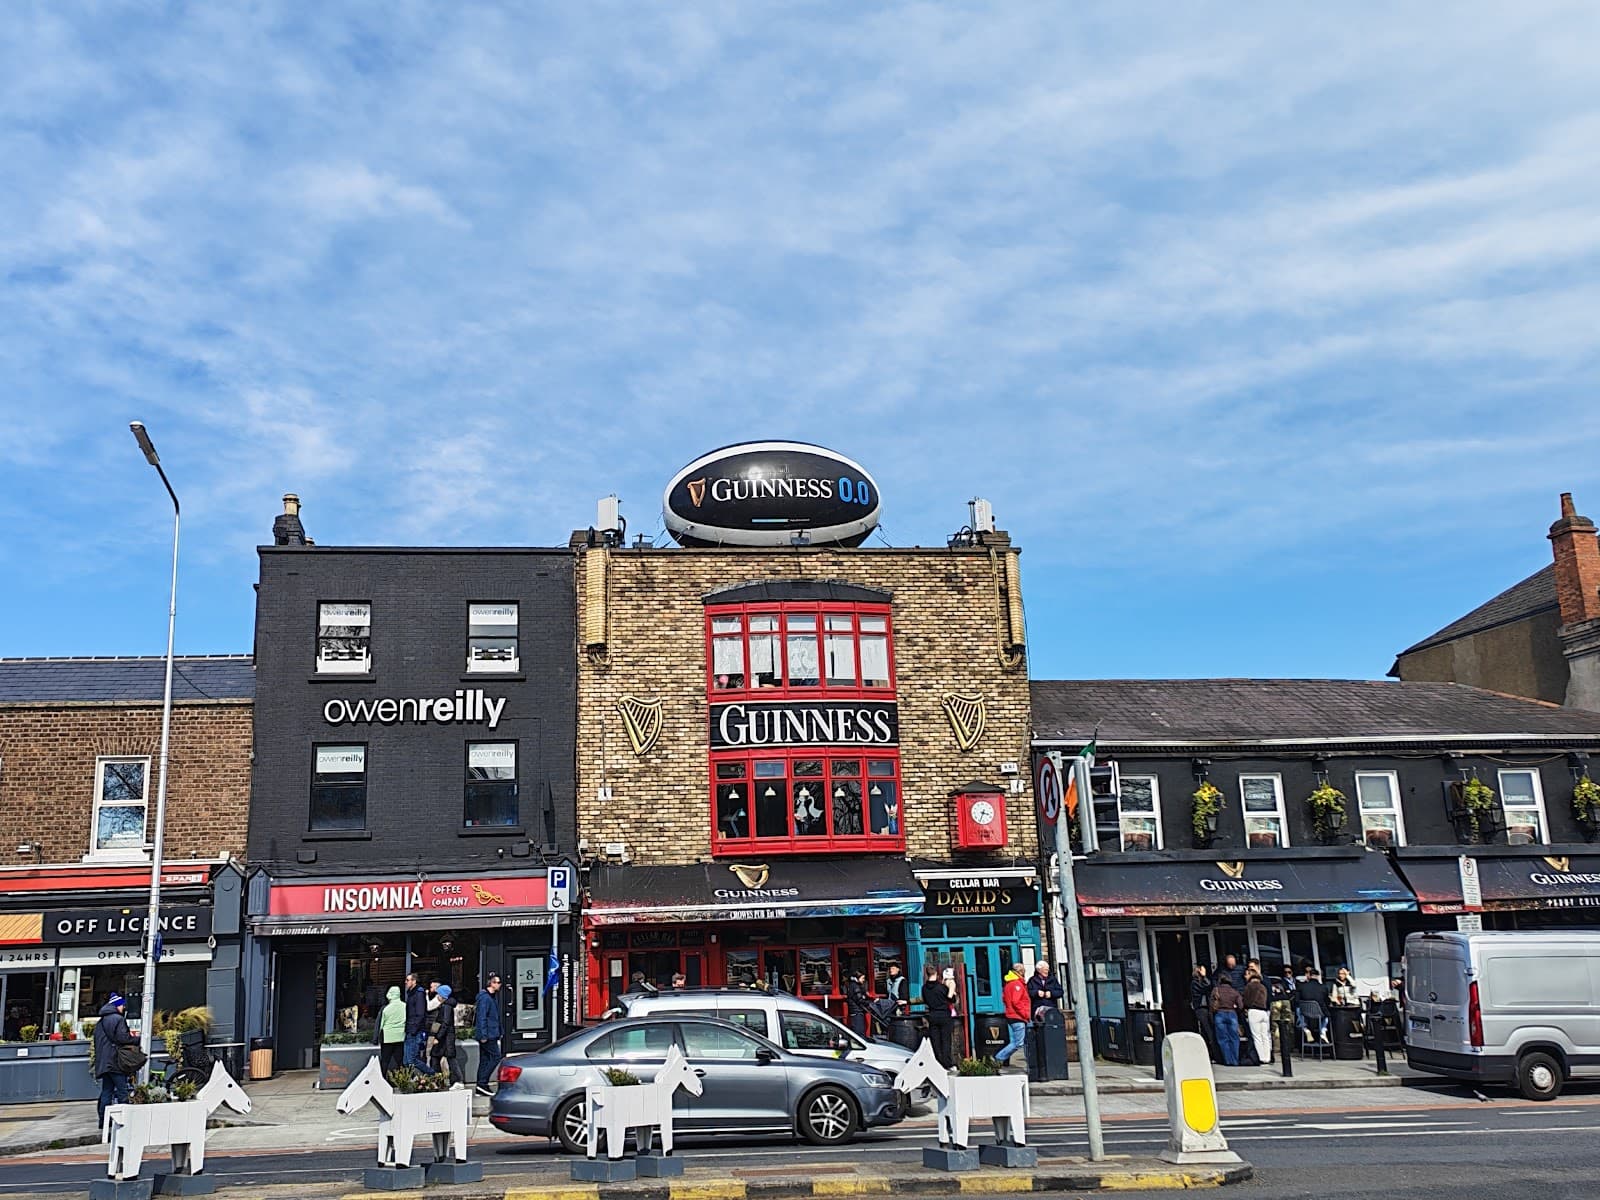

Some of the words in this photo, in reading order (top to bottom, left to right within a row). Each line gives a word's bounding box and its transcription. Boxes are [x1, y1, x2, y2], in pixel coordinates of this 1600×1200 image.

[712, 478, 833, 501] GUINNESS
[838, 477, 869, 505] 0.0
[323, 608, 368, 618] owenreilly
[472, 607, 514, 617] owenreilly
[324, 689, 506, 727] owenreilly
[719, 704, 893, 744] GUINNESS
[319, 754, 363, 764] owenreilly
[553, 871, 565, 887] P
[949, 879, 980, 889] CELLAR
[983, 878, 1000, 888] BAR
[432, 885, 462, 894] COFFEE
[1200, 879, 1283, 891] GUINNESS
[714, 888, 799, 898] GUINNESS
[936, 889, 1012, 906] DAVID'S
[324, 886, 423, 912] INSOMNIA
[432, 897, 469, 907] COMPANY
[951, 906, 980, 914] CELLAR
[1225, 905, 1249, 913] MARY
[57, 919, 98, 934] OFF
[9, 952, 49, 962] 24HRS
[97, 951, 130, 960] OPEN
[526, 969, 534, 980] 8
